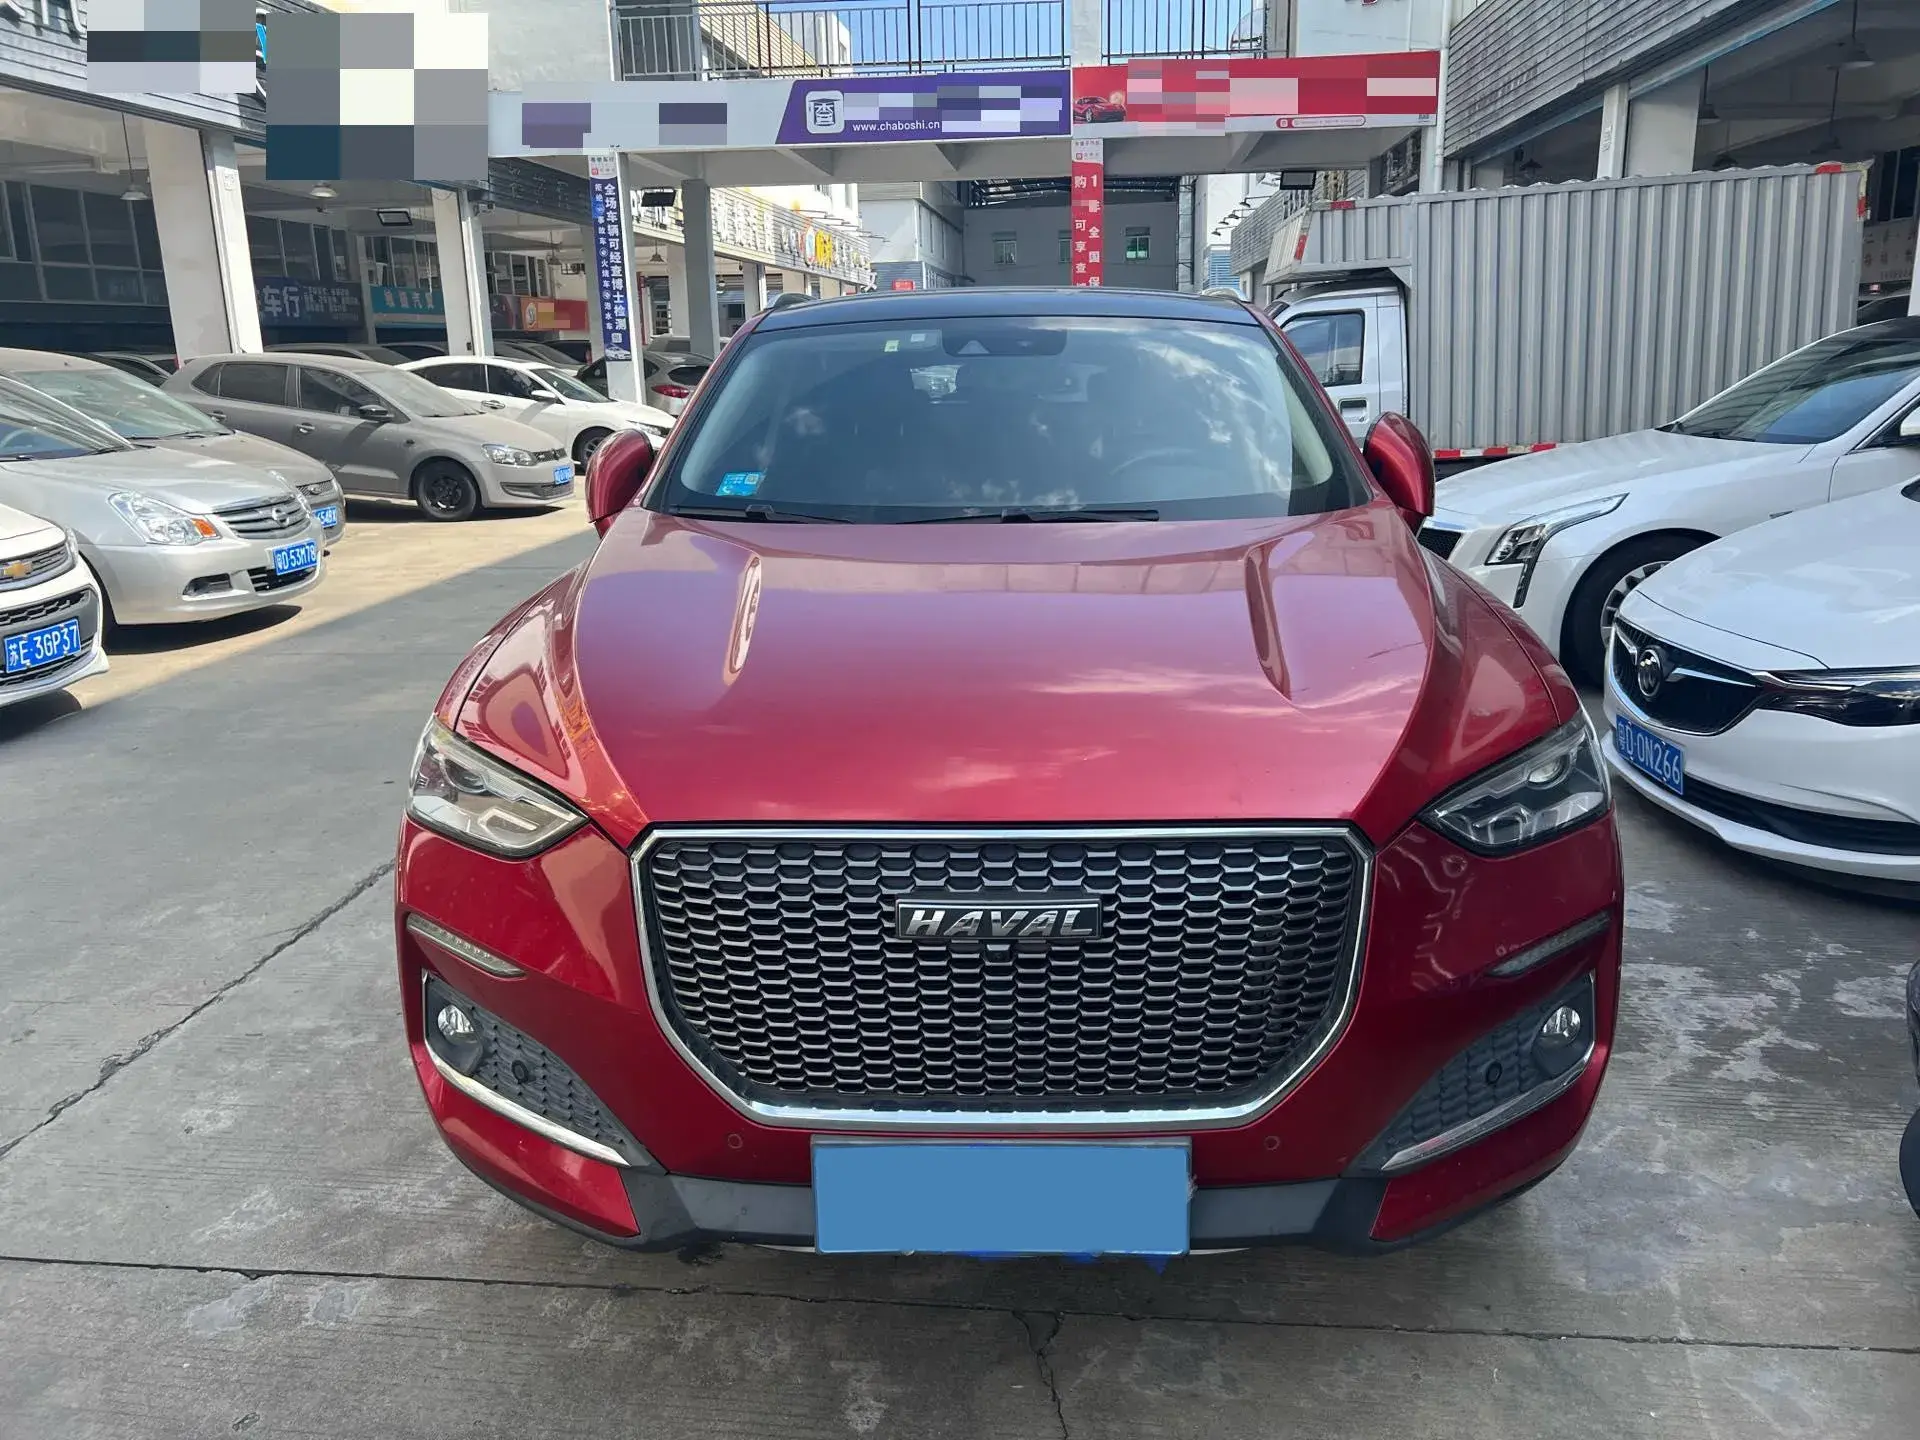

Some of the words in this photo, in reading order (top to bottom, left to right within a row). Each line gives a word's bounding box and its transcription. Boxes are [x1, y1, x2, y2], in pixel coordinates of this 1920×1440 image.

[852, 119, 940, 132] www.chaboshi.cn
[604, 183, 627, 331] 全场车辆可经查博士检测
[255, 284, 300, 317] 车行
[905, 909, 1093, 936] HAVAL
